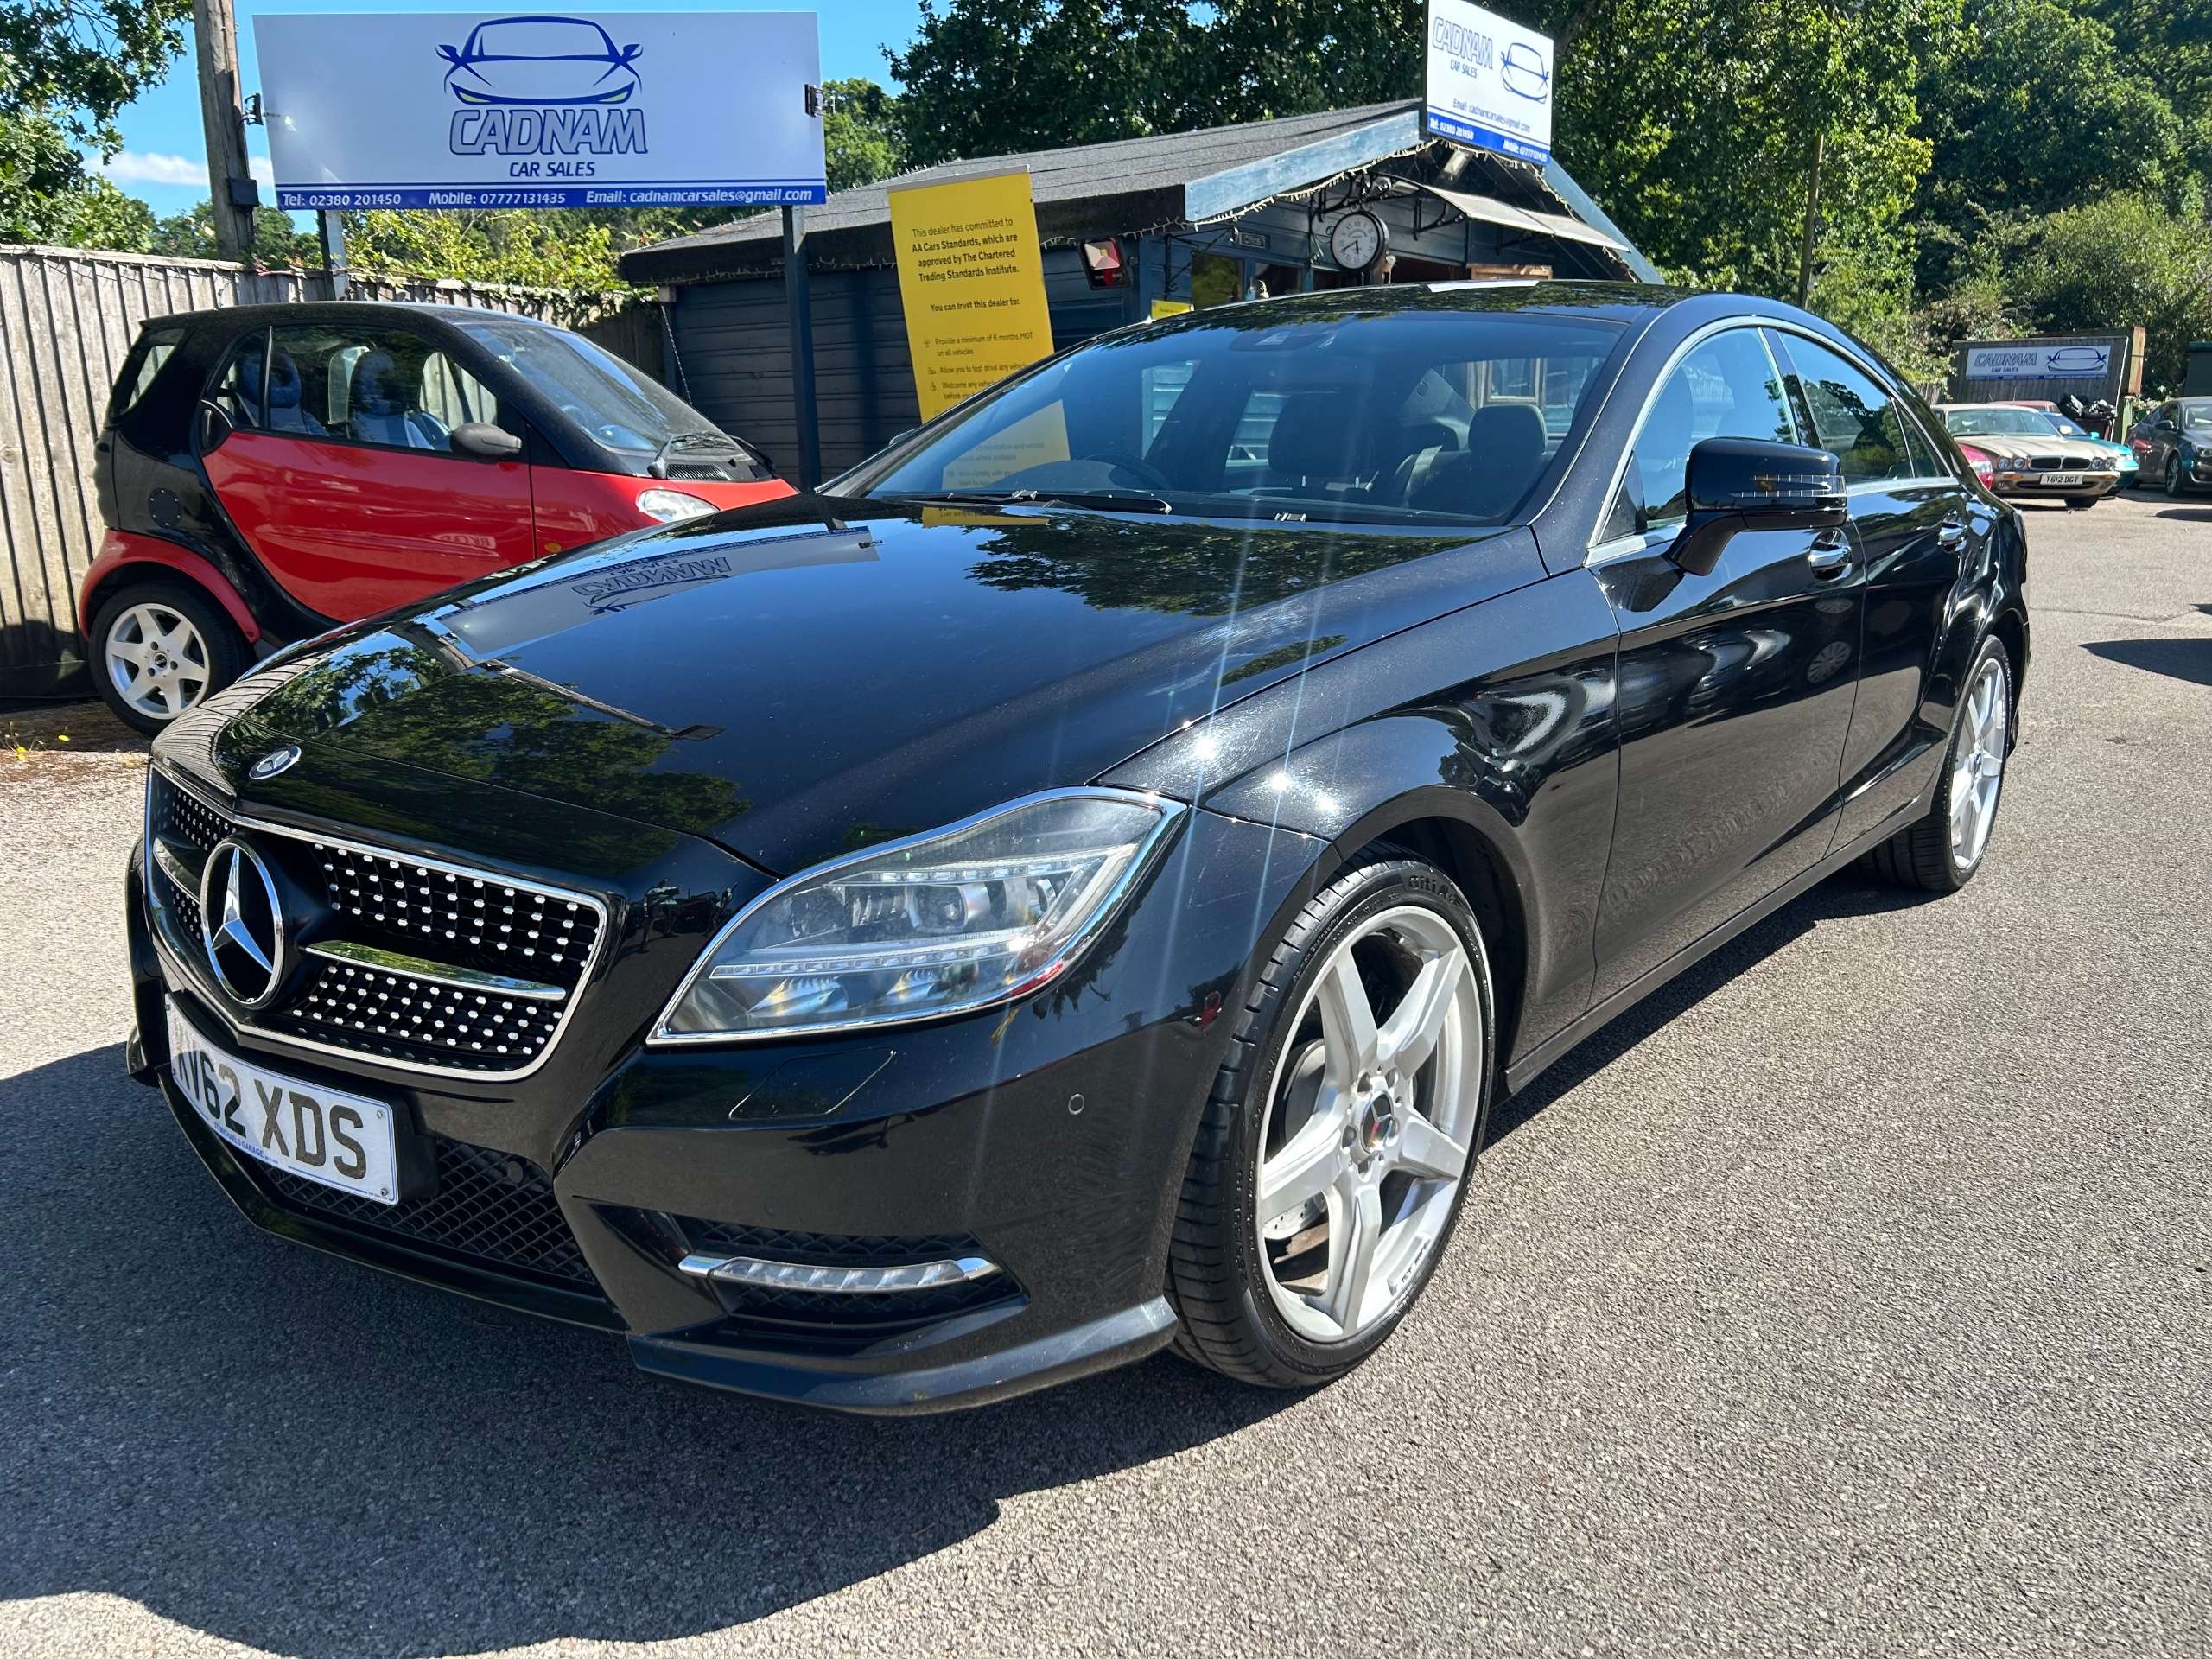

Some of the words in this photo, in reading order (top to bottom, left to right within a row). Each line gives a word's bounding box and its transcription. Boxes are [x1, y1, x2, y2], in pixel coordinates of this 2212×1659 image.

[1433, 16, 1493, 70] CADNAM
[1451, 60, 1461, 73] CAR
[1462, 63, 1478, 79] SALES
[449, 109, 649, 156] CADNAM
[509, 162, 540, 177] CAR
[545, 161, 595, 177] SALES
[283, 194, 305, 207] Tel:
[309, 194, 349, 207] 02380
[353, 194, 401, 206] 201450
[429, 192, 476, 206] Mobile:
[480, 193, 566, 205] 07777131435
[586, 189, 626, 203] Email:
[629, 188, 813, 204] cadnamcarsales@gmail.com
[912, 228, 928, 238] This
[928, 226, 950, 236] dealer
[950, 224, 964, 233] has
[964, 218, 1003, 232] committed
[1004, 217, 1014, 226] to
[912, 243, 923, 253] AA
[923, 242, 940, 252] Cars
[941, 237, 982, 251] Standards,
[982, 233, 1004, 245] which
[1005, 233, 1018, 243] are
[918, 255, 952, 268] approved
[952, 254, 962, 265] by
[963, 252, 976, 263] The
[978, 248, 1016, 261] Chartered
[918, 271, 946, 283] Trading
[946, 267, 984, 280] Standards
[985, 264, 1020, 276] Institute.
[930, 303, 944, 312] You
[957, 301, 973, 310] trust
[973, 299, 987, 309] this
[987, 297, 1009, 308] dealer
[935, 337, 957, 346] Provide
[1019, 331, 1033, 340] MOT
[952, 347, 975, 357] vehicles
[1974, 352, 2037, 367] CADNAM
[2046, 474, 2063, 484] T612
[1409, 874, 1437, 893] Giti
[254, 1078, 367, 1180] XDS
